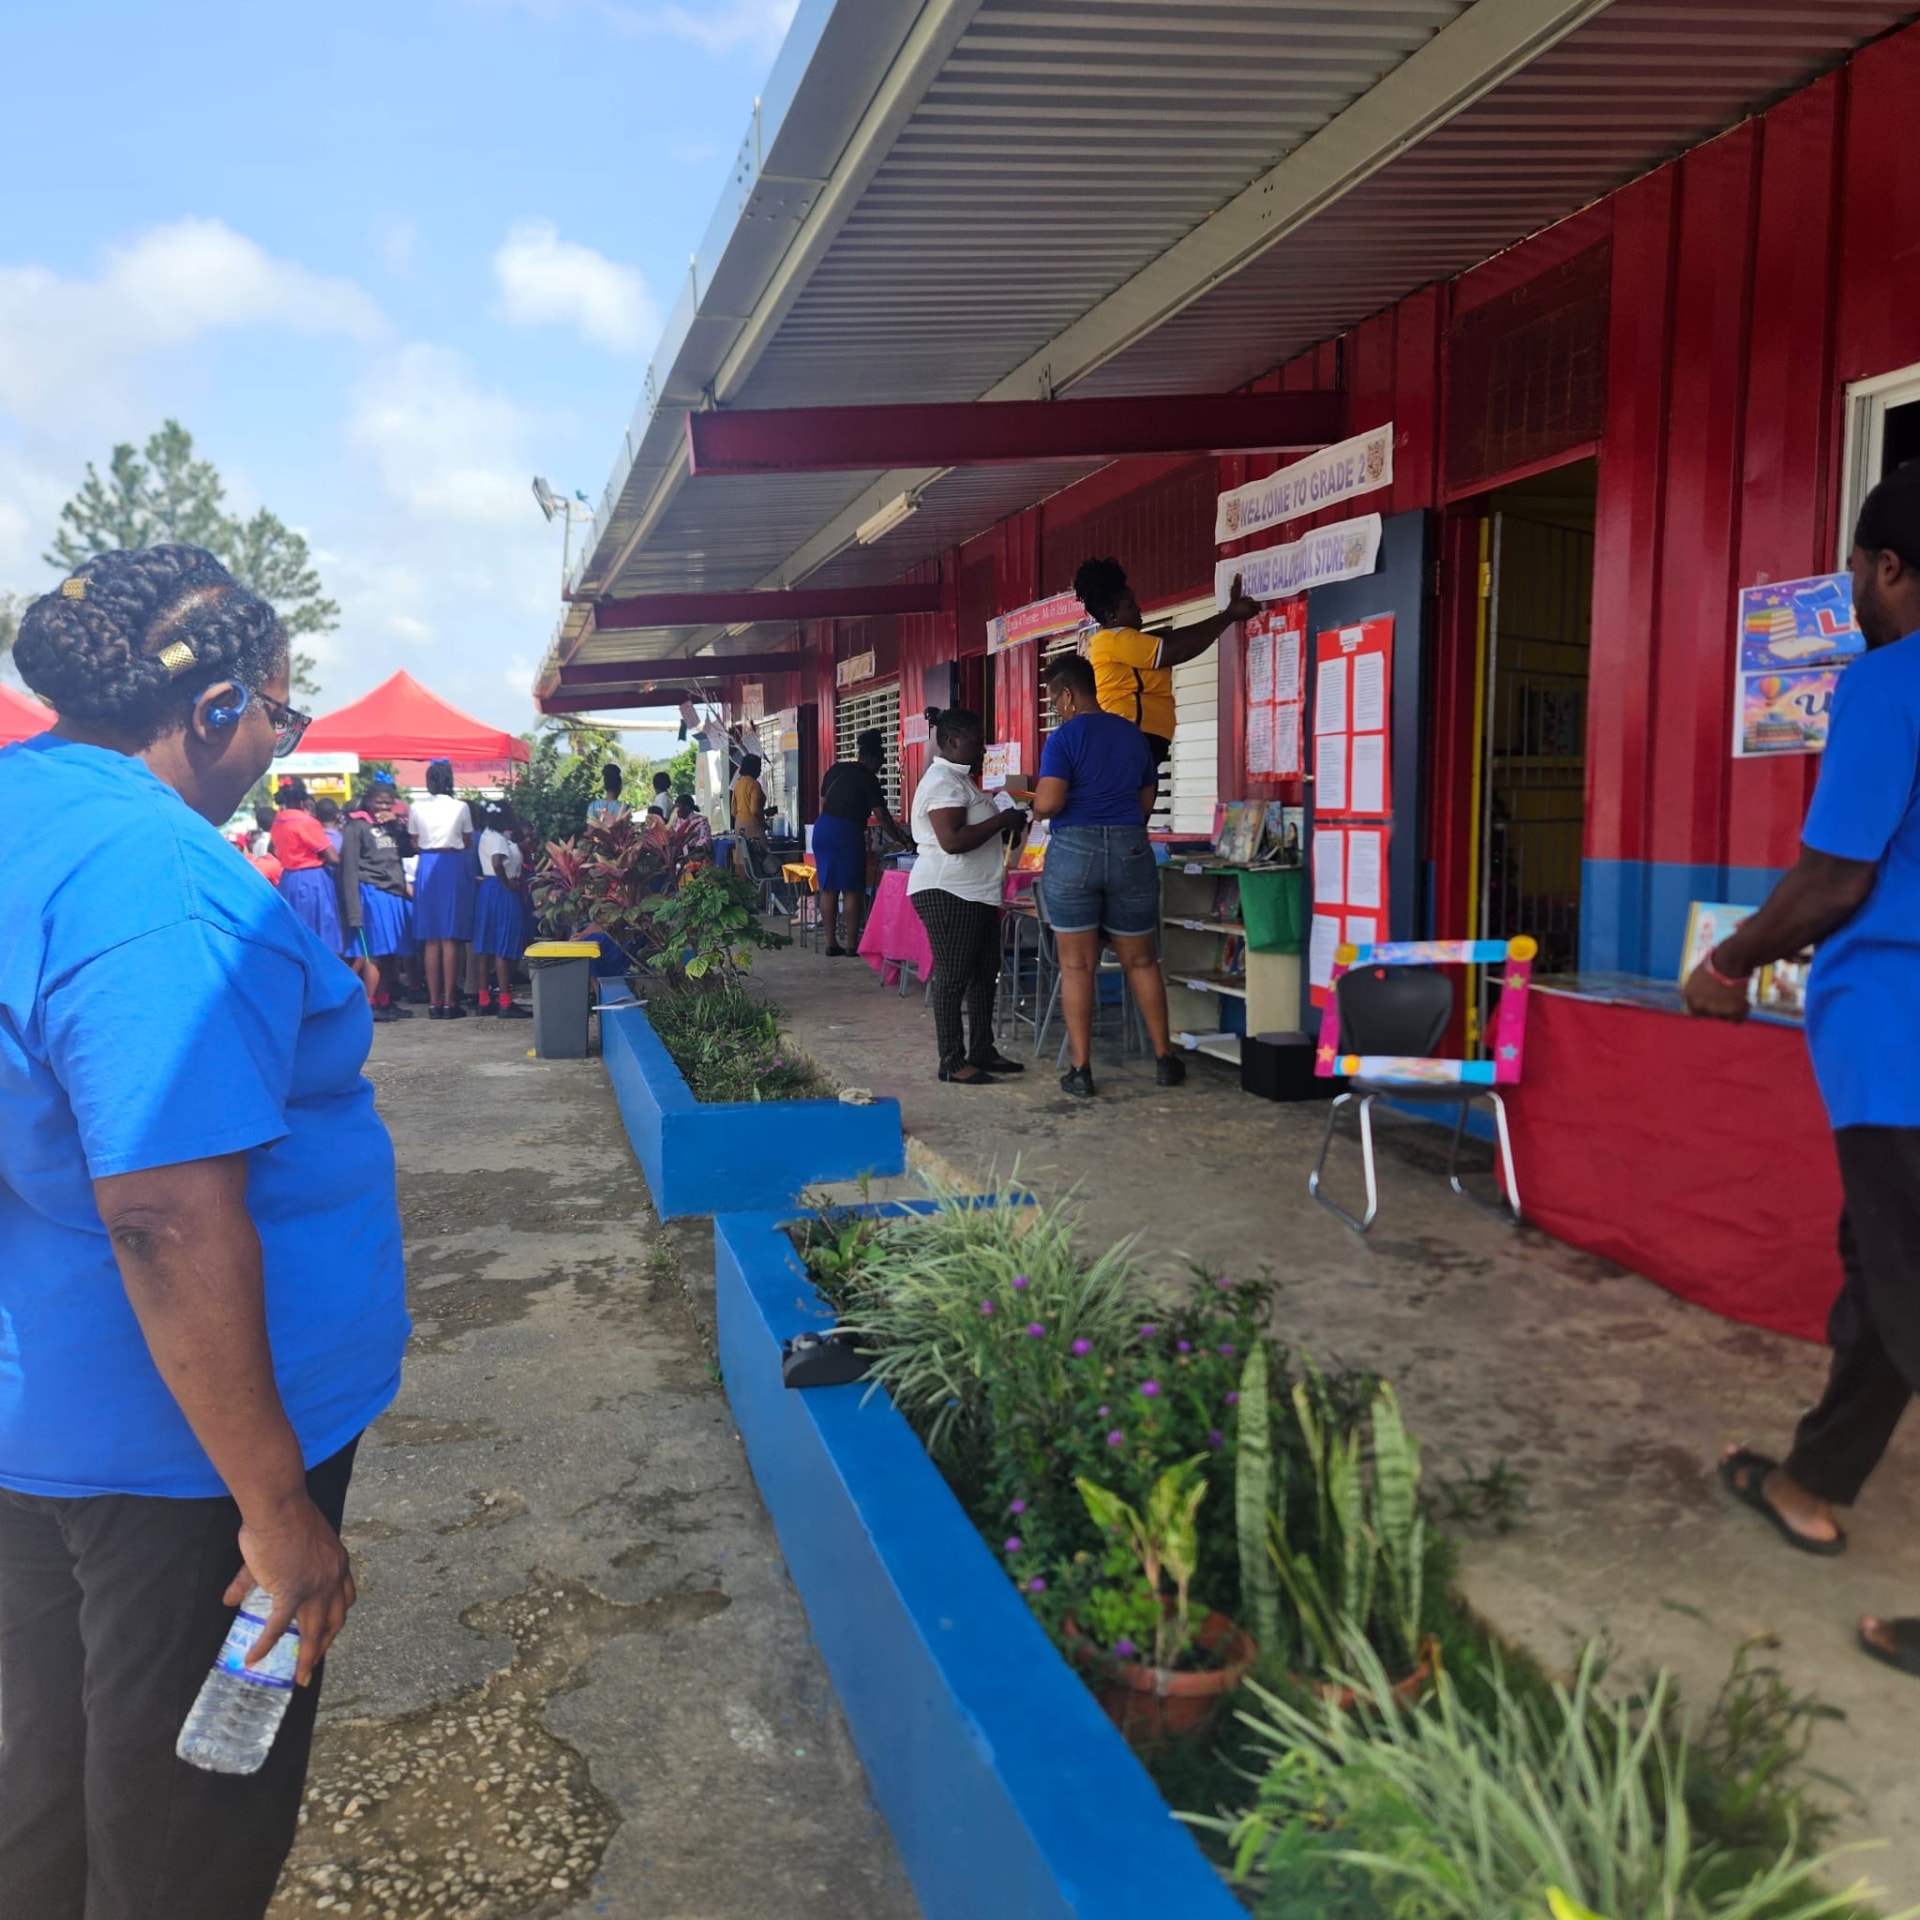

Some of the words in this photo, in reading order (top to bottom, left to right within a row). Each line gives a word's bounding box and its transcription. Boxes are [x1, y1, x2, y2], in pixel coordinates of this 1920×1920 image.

[1240, 484, 1291, 528] WELCOME
[1293, 478, 1307, 508] TO
[1310, 457, 1354, 500] GRADE
[1357, 453, 1366, 485] 2
[1314, 534, 1345, 576] STORE
